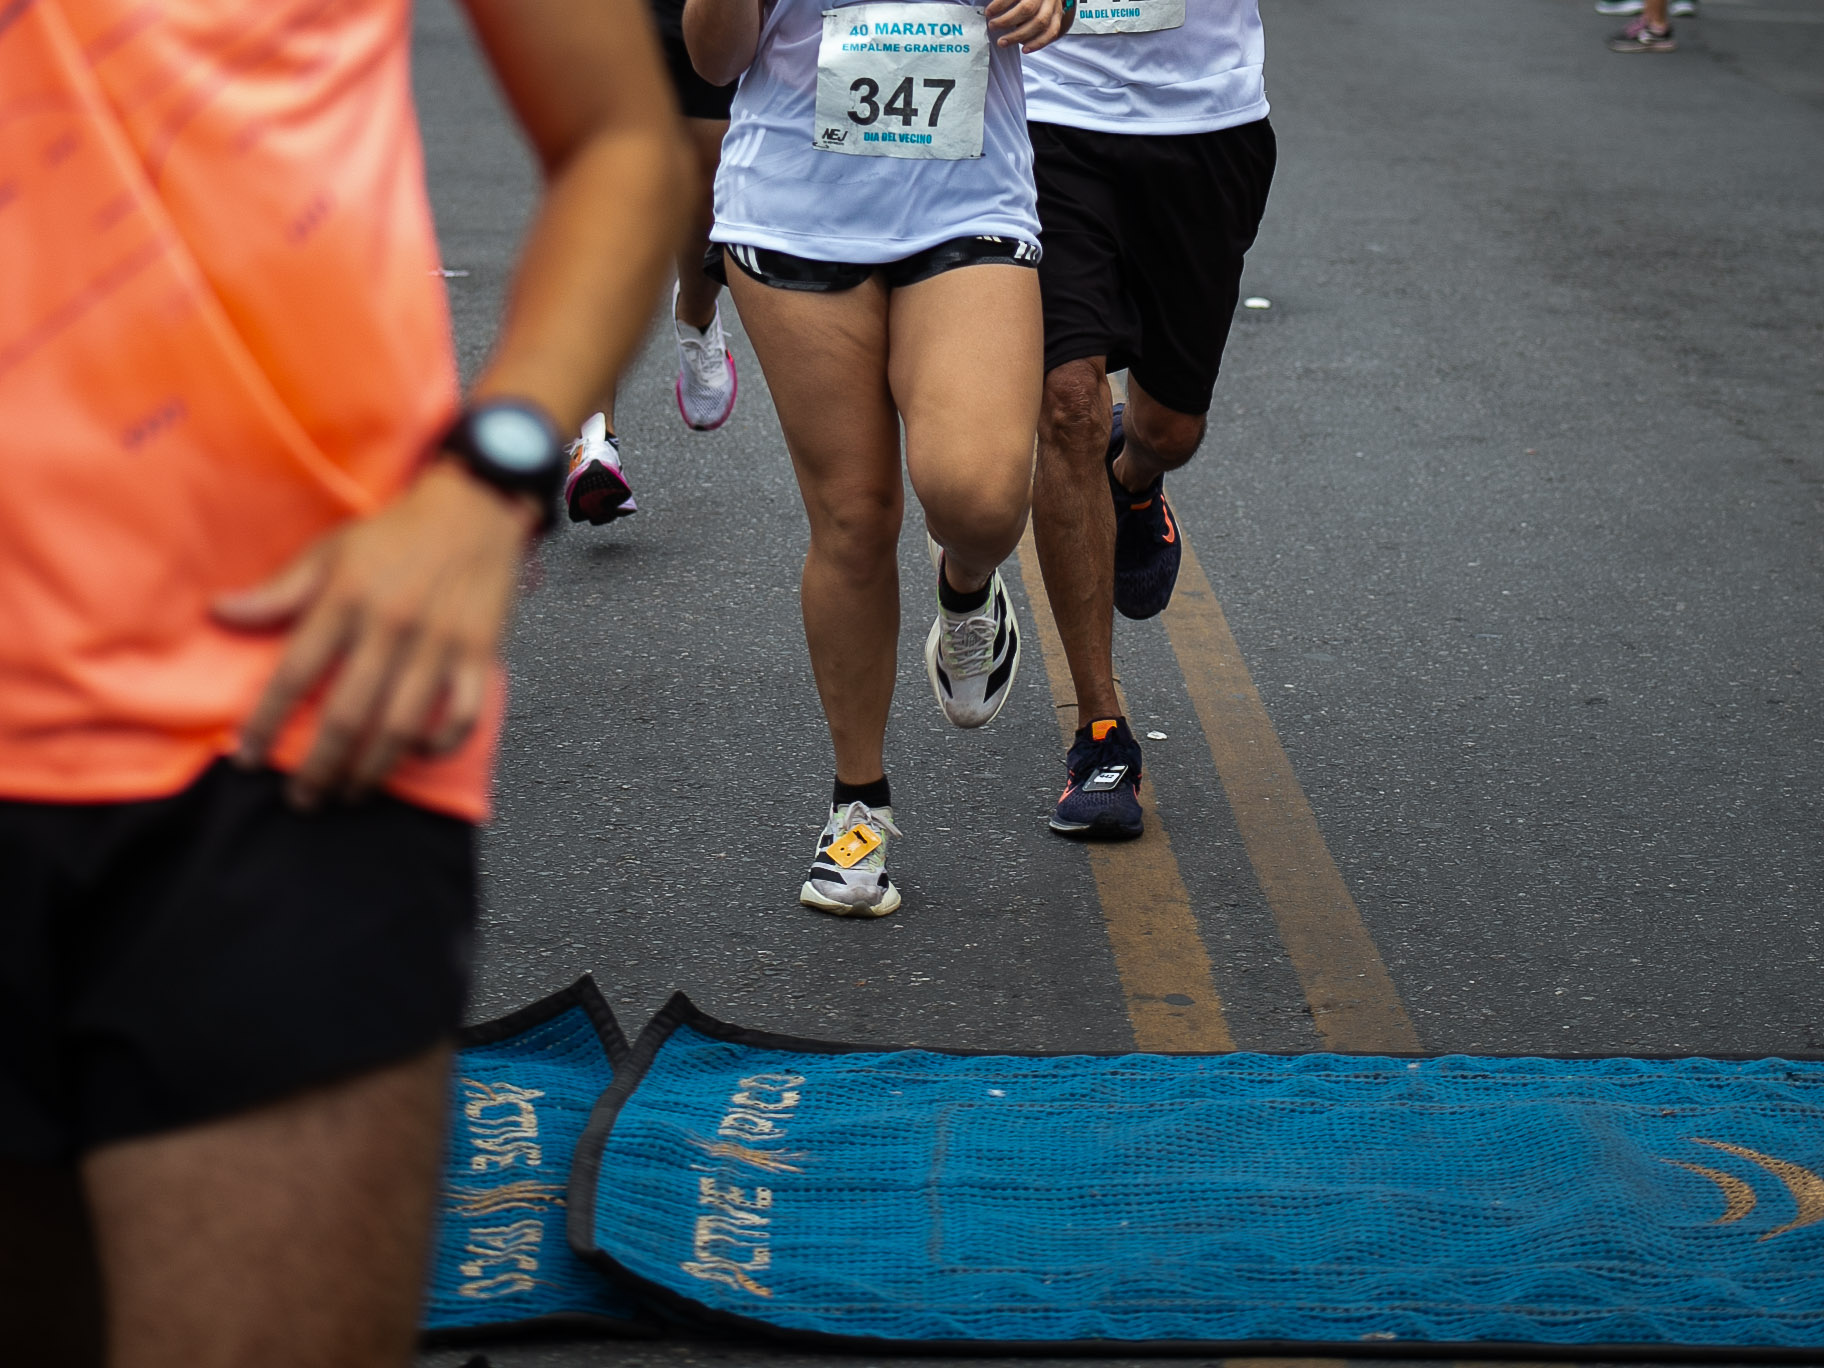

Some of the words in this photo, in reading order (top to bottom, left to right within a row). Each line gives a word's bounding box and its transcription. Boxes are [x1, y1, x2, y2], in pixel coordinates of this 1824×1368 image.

[1080, 9, 1094, 18] DIA
[1095, 9, 1109, 18] DEL
[1110, 7, 1140, 17] VECINO
[849, 24, 868, 36] 40
[875, 23, 964, 36] MARATON
[842, 43, 900, 52] EMPALME
[904, 44, 970, 53] GRANEROS
[847, 76, 956, 127] 347
[822, 128, 848, 142] NEJ
[863, 132, 880, 141] DIA
[881, 132, 896, 142] DEL
[899, 133, 932, 144] VECINO
